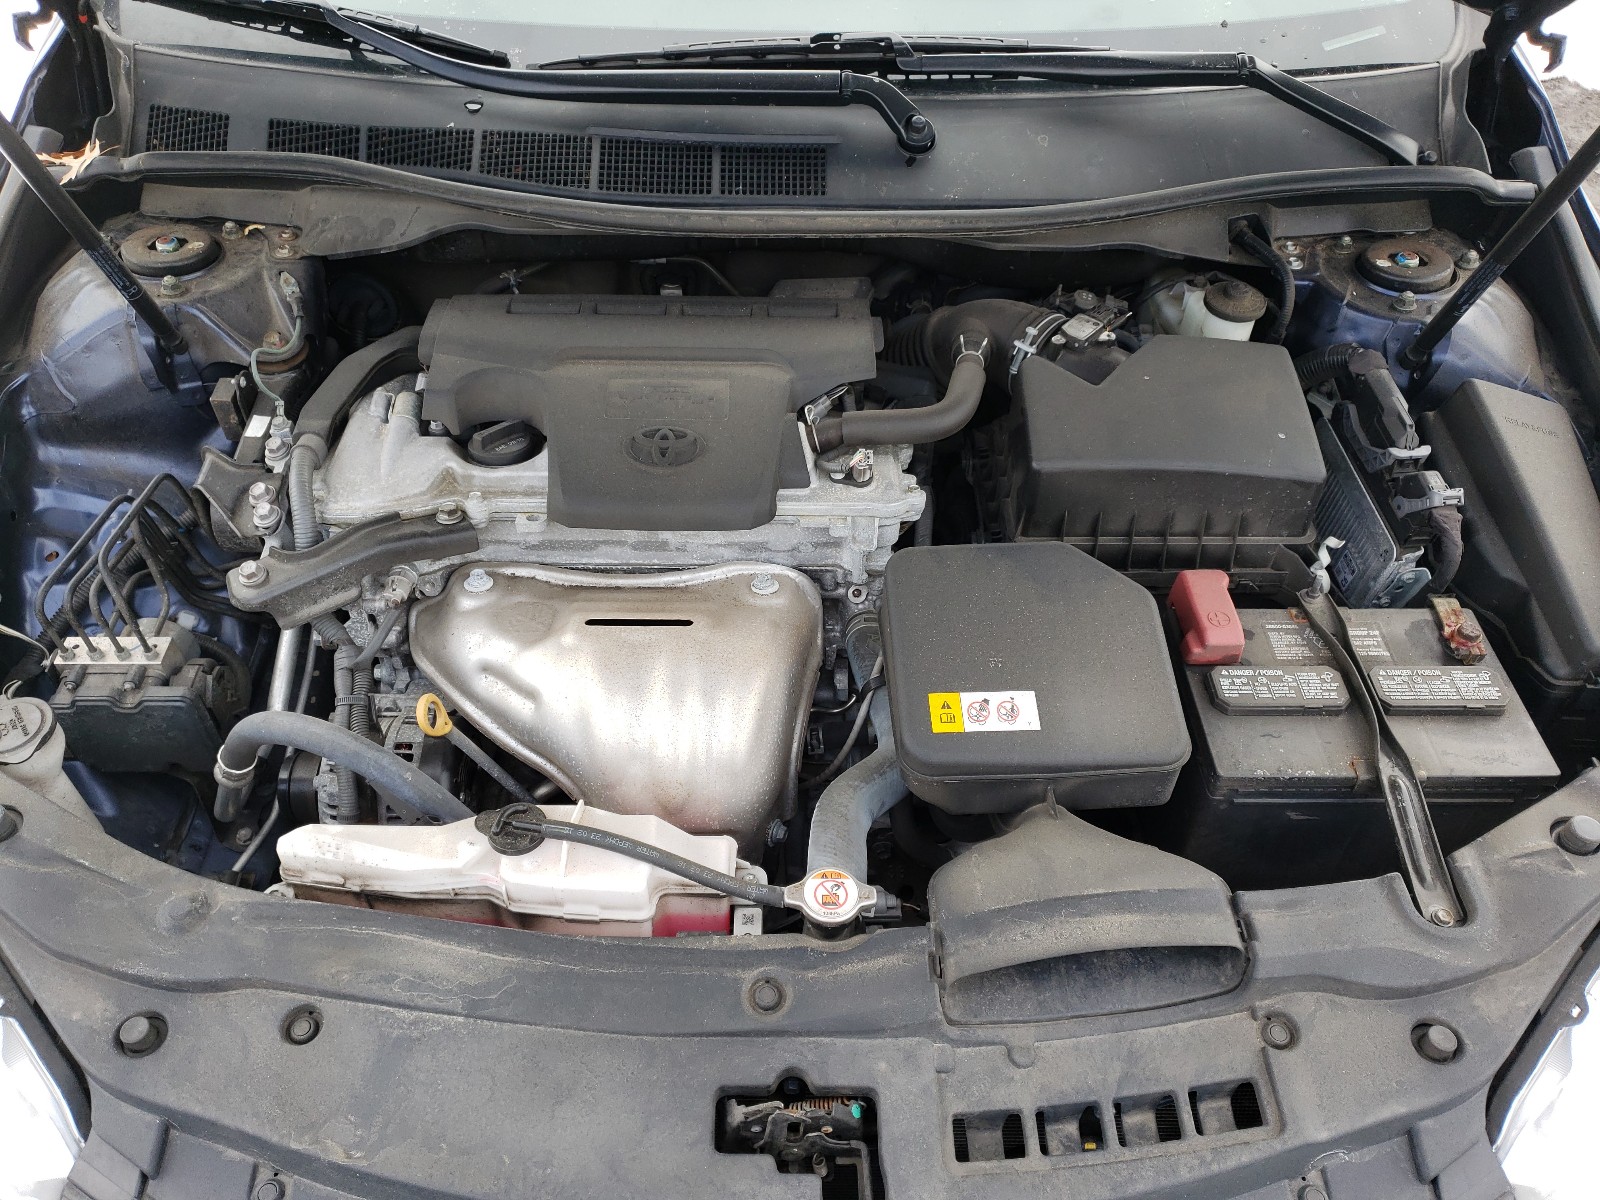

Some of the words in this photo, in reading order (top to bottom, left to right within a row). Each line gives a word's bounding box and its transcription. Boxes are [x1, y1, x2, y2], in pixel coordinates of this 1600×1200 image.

[576, 829, 588, 837] 02
[590, 832, 602, 841] 23
[635, 845, 660, 859] WATER
[702, 870, 714, 879] 23
[746, 884, 769, 895] WATER
